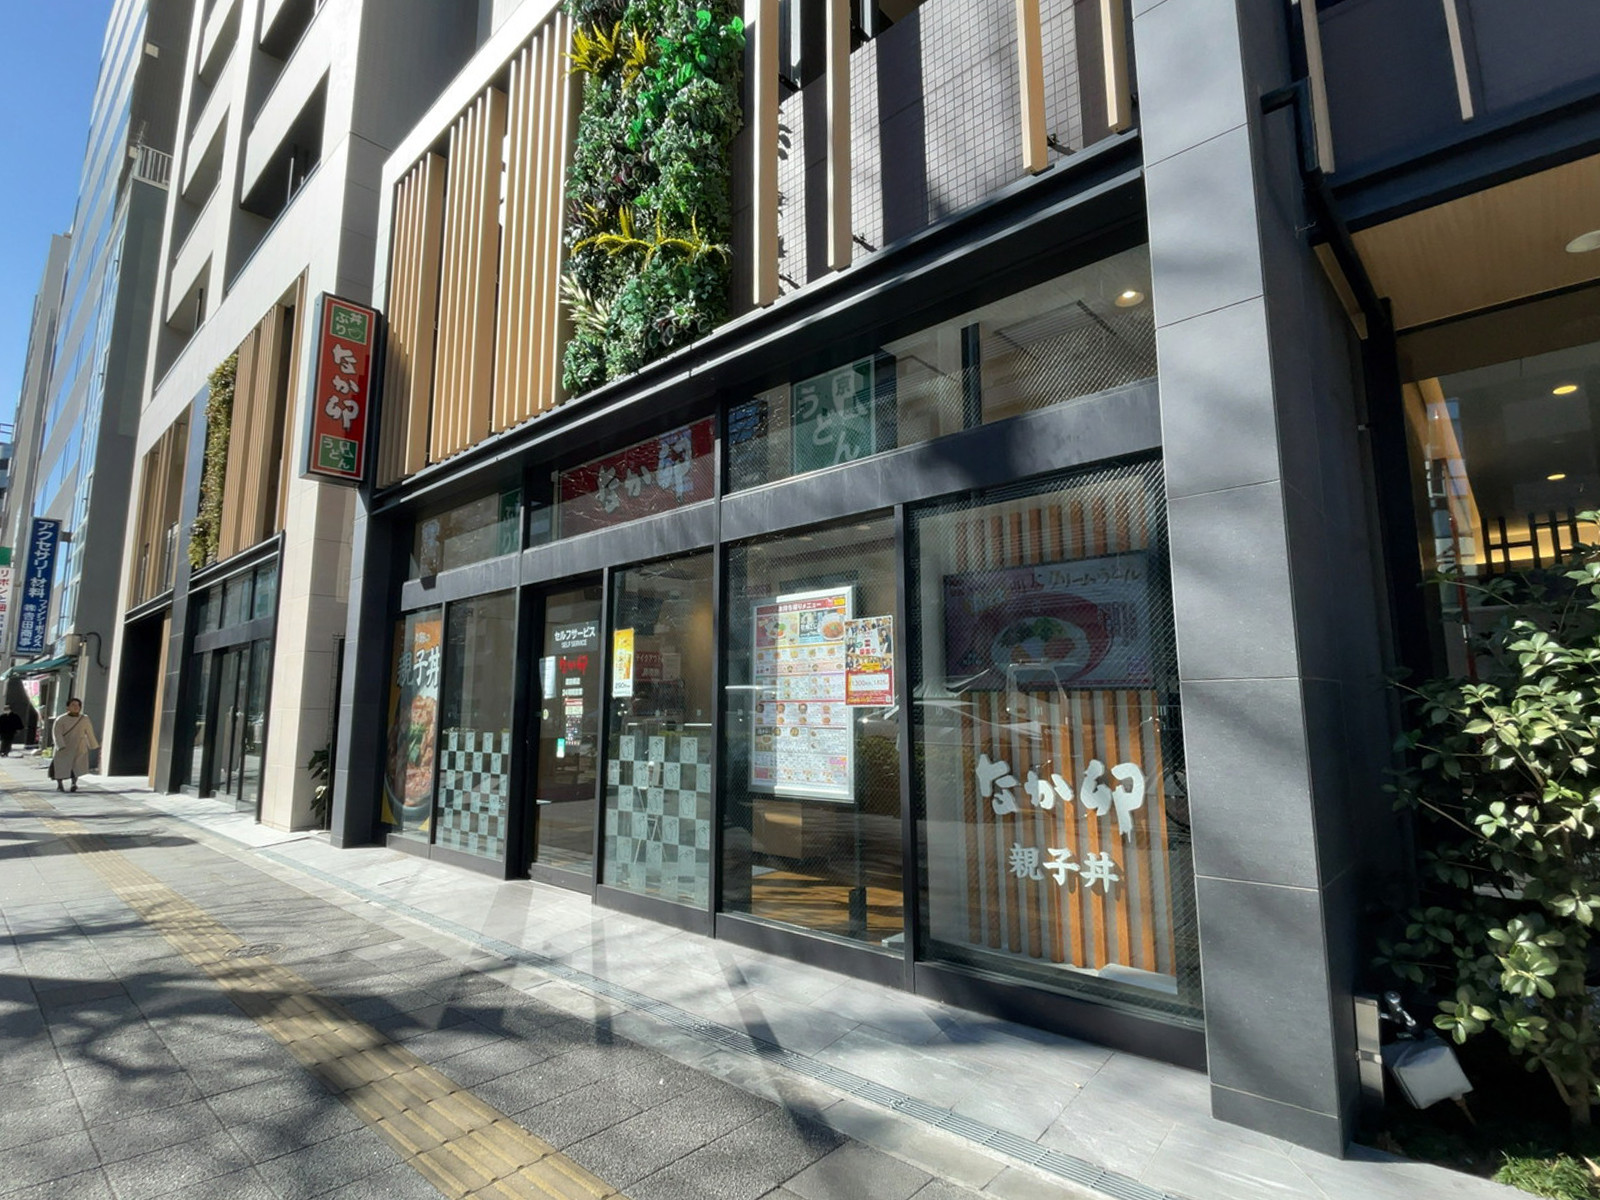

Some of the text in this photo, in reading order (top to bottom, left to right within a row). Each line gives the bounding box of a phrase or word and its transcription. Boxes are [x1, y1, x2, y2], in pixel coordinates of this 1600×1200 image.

[325, 343, 360, 432] なか卯
[595, 437, 692, 514] なか卯
[28, 521, 55, 599] アクセサリー材料
[554, 626, 596, 642] セルフサービス
[975, 753, 1146, 843] なか卯
[1008, 842, 1120, 894] 親子丼
